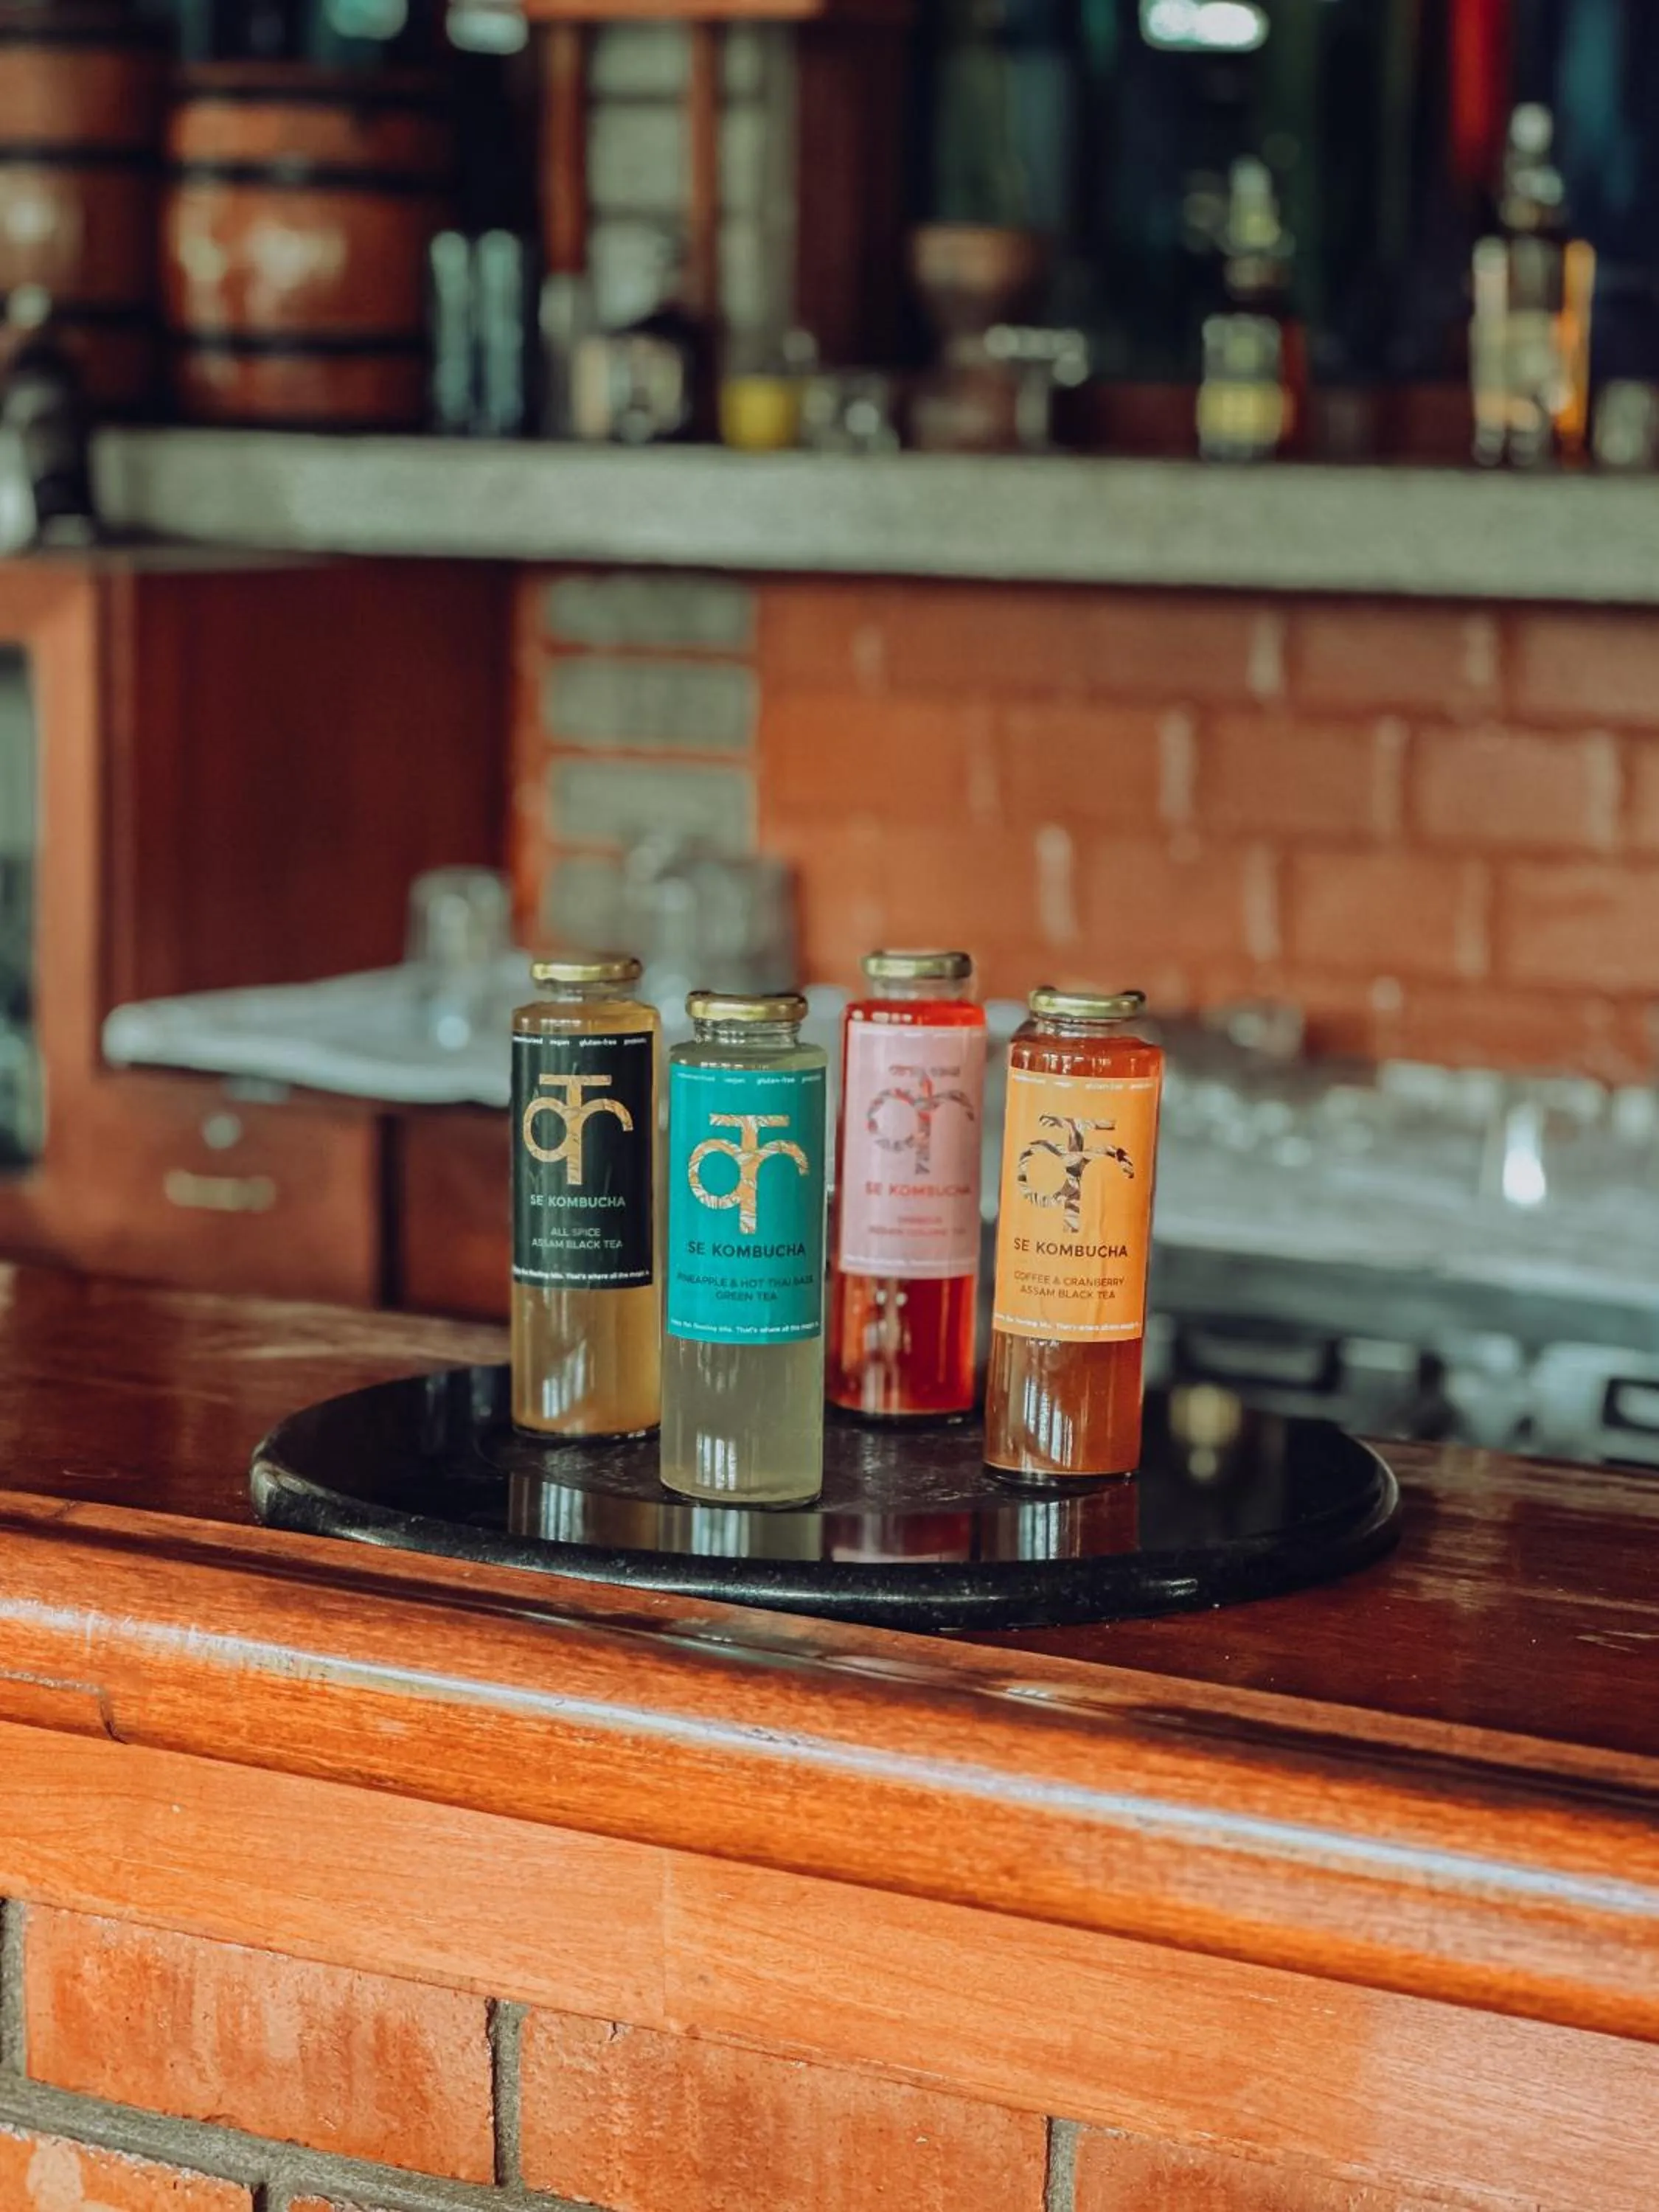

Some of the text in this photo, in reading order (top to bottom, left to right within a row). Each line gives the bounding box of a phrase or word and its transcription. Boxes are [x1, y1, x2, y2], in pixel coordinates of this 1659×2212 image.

[530, 1194, 625, 1208] SE KOMBUCHA
[551, 1227, 601, 1237] ALL SPICE
[532, 1238, 623, 1249] ASSAM BLACK TEA
[688, 1241, 807, 1259] SE KOMBUCHA
[1014, 1237, 1128, 1257] SE KOMBUCHA
[740, 1277, 765, 1288] HOT
[768, 1276, 792, 1287] THAI
[1014, 1270, 1050, 1284] COFFEE
[1062, 1276, 1125, 1287] CRANBERRY
[715, 1292, 778, 1301] GREEN TEA
[1020, 1285, 1116, 1300] ASSAM BLACK TEA
